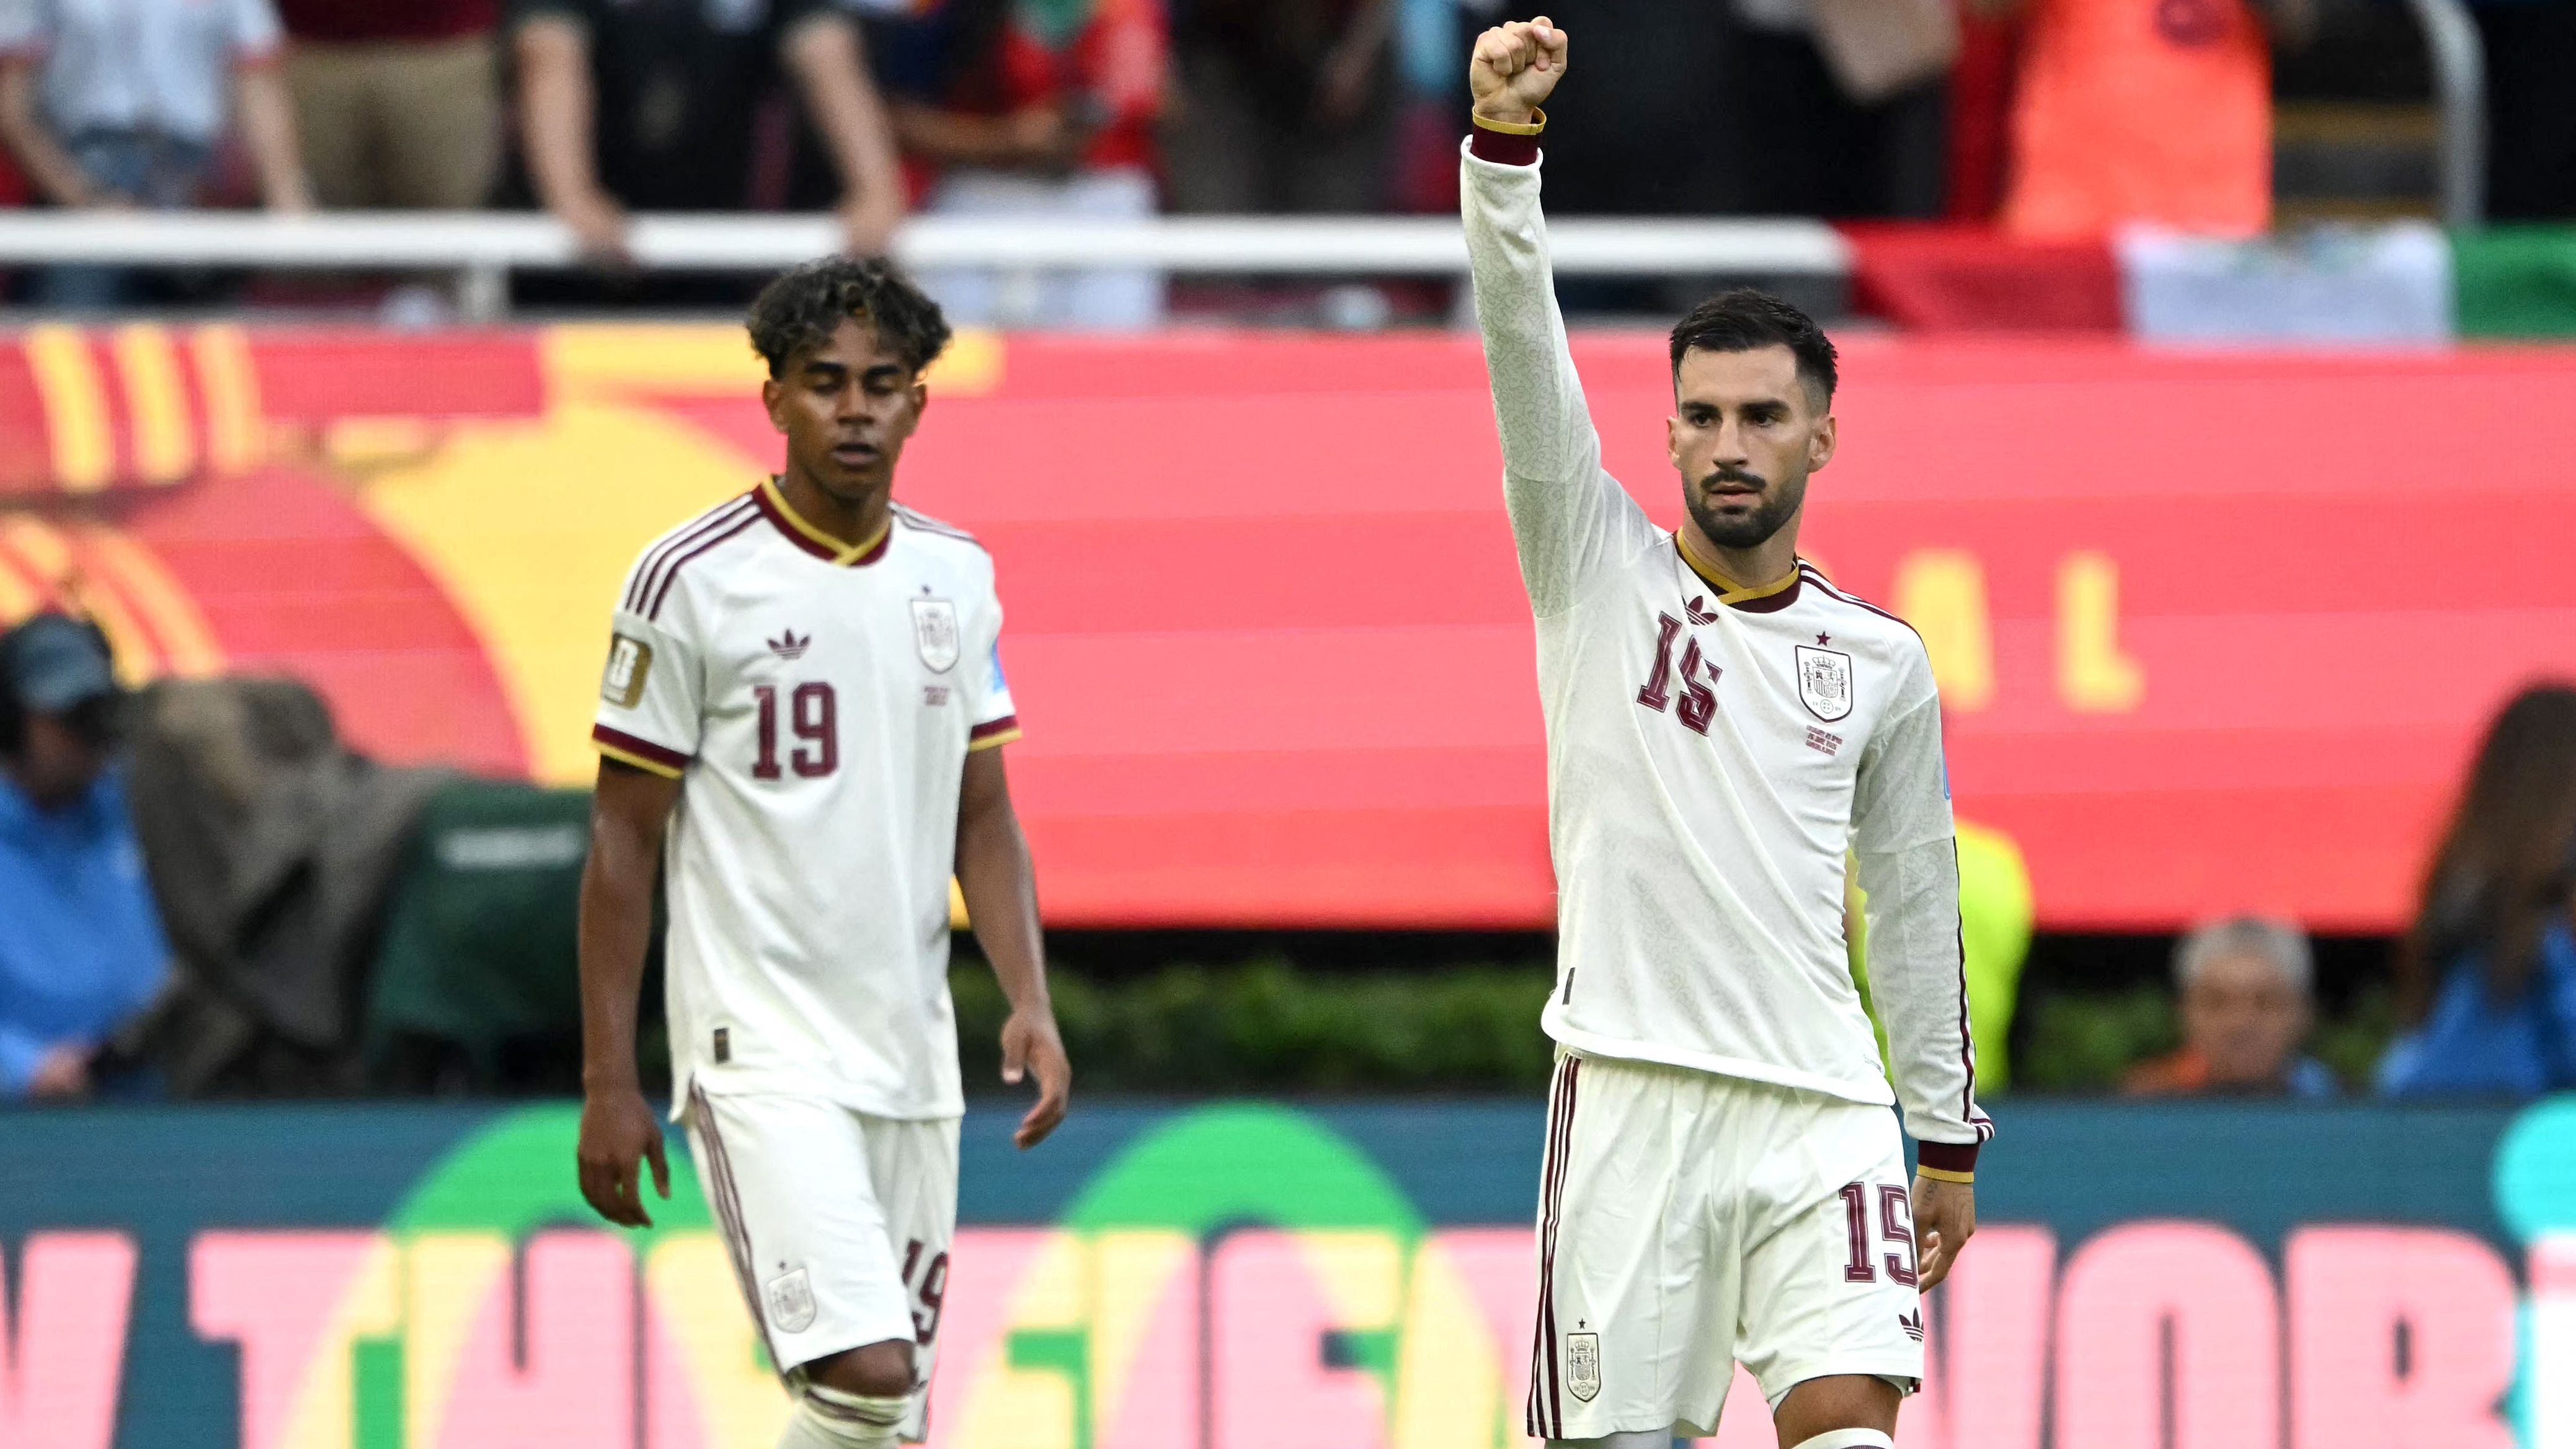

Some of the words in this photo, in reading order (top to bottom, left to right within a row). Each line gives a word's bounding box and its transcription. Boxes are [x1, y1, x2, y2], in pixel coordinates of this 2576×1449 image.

[1636, 610, 1723, 737] 15
[752, 681, 839, 781] 19
[1839, 1181, 1919, 1288] 15
[902, 1239, 949, 1346] 19
